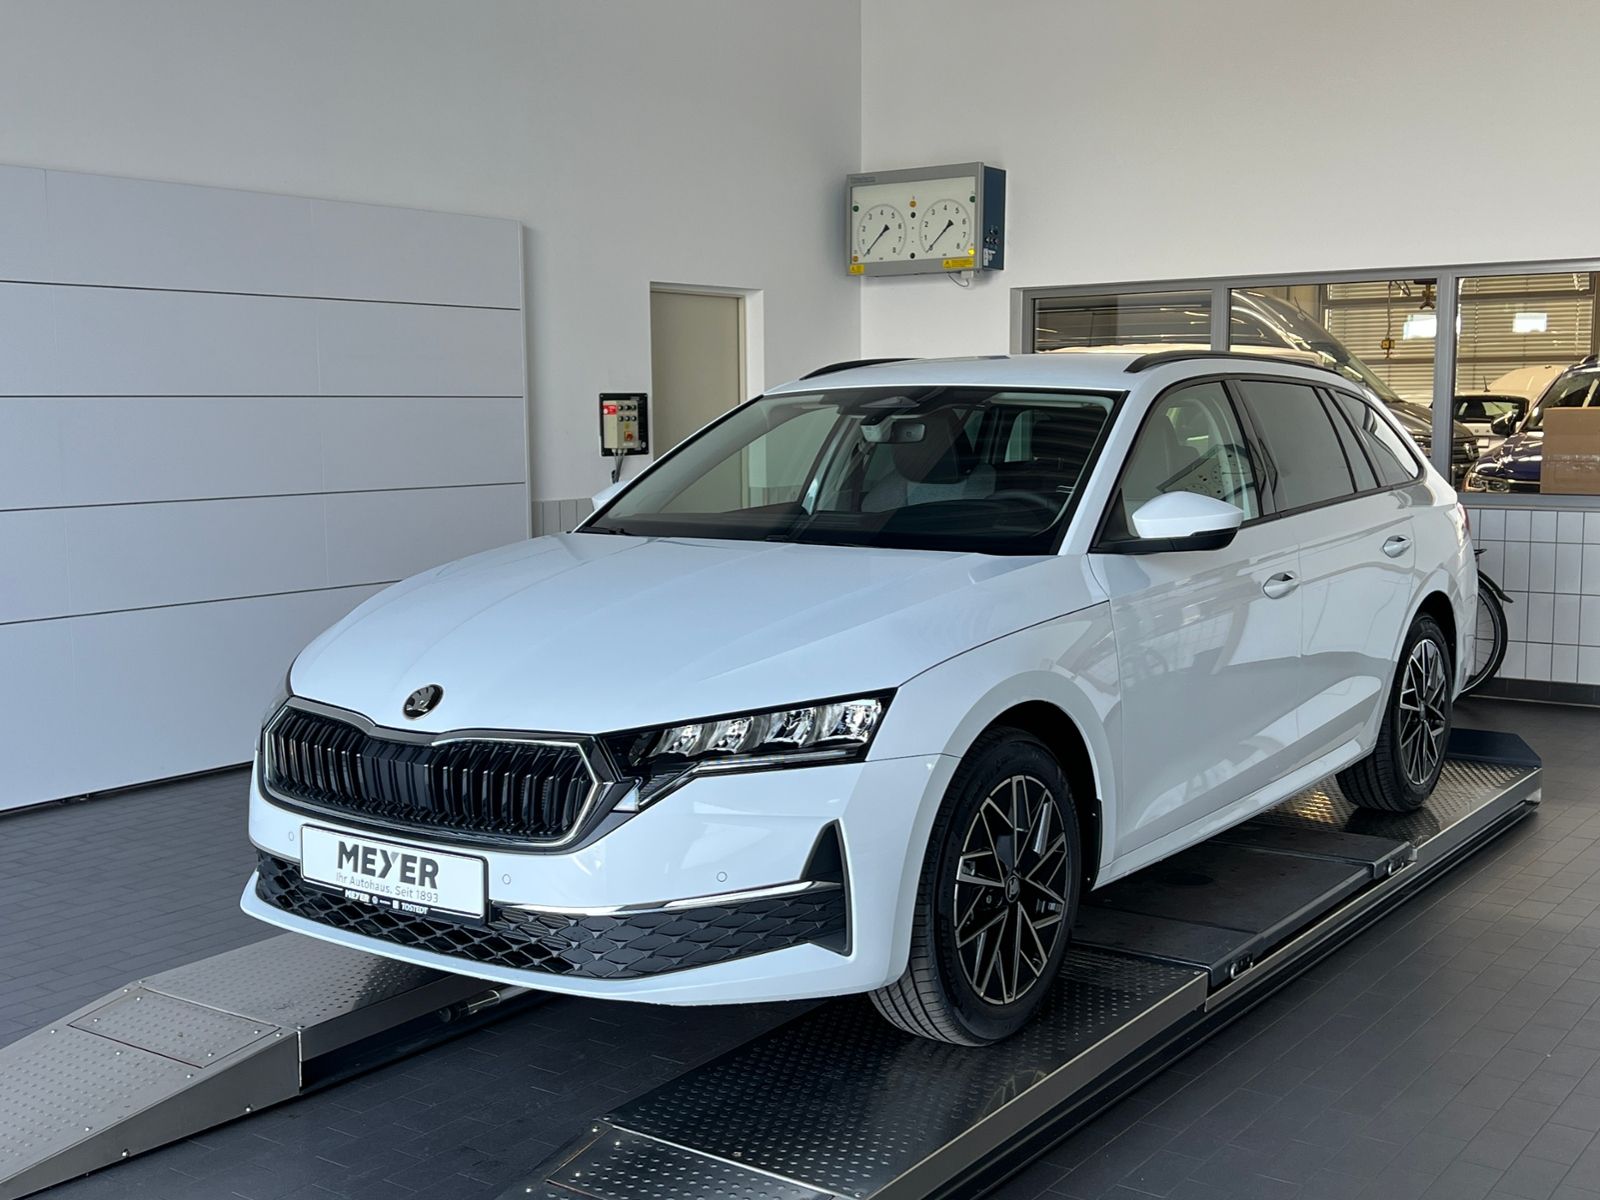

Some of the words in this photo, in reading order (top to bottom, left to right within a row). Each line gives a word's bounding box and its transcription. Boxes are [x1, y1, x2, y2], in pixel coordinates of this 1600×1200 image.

[337, 841, 439, 890] MEYER
[336, 871, 348, 884] Ihr
[350, 874, 393, 894] Autohaus.
[395, 885, 413, 899] Seit
[416, 890, 439, 904] 1893
[401, 902, 429, 915] TOSTEDT
